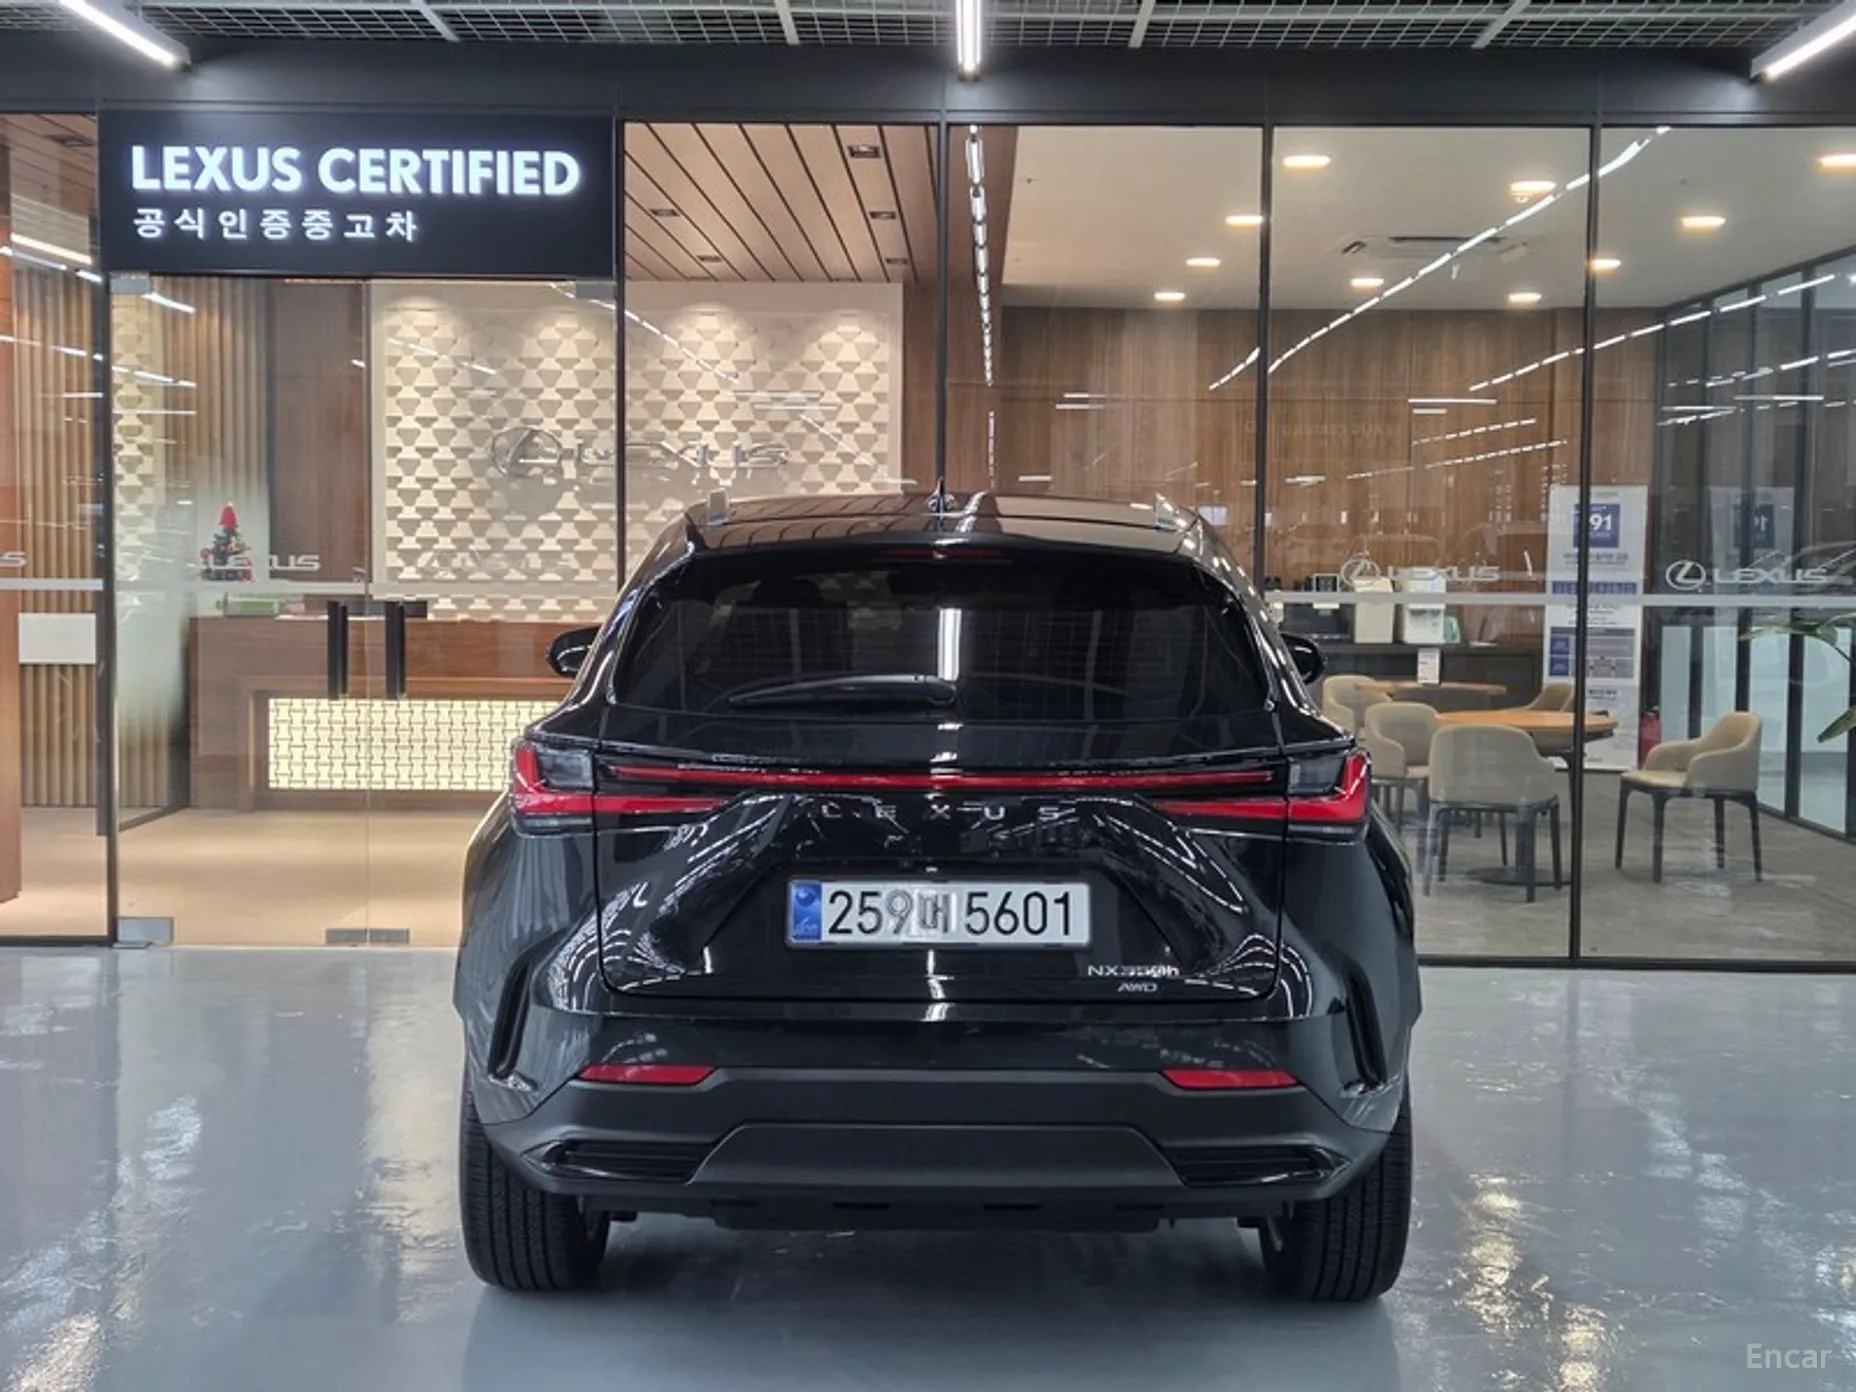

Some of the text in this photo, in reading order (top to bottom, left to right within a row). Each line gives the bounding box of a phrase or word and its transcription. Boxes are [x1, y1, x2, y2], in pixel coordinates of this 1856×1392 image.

[131, 145, 581, 196] LEXUS CERTIFIED
[133, 207, 418, 242] 공식인증중고차
[208, 555, 320, 570] LEUS
[1714, 568, 1828, 584] LEXUS
[821, 804, 1060, 821] LEXUS
[965, 890, 1070, 935] 5601
[1117, 982, 1158, 993] AWD
